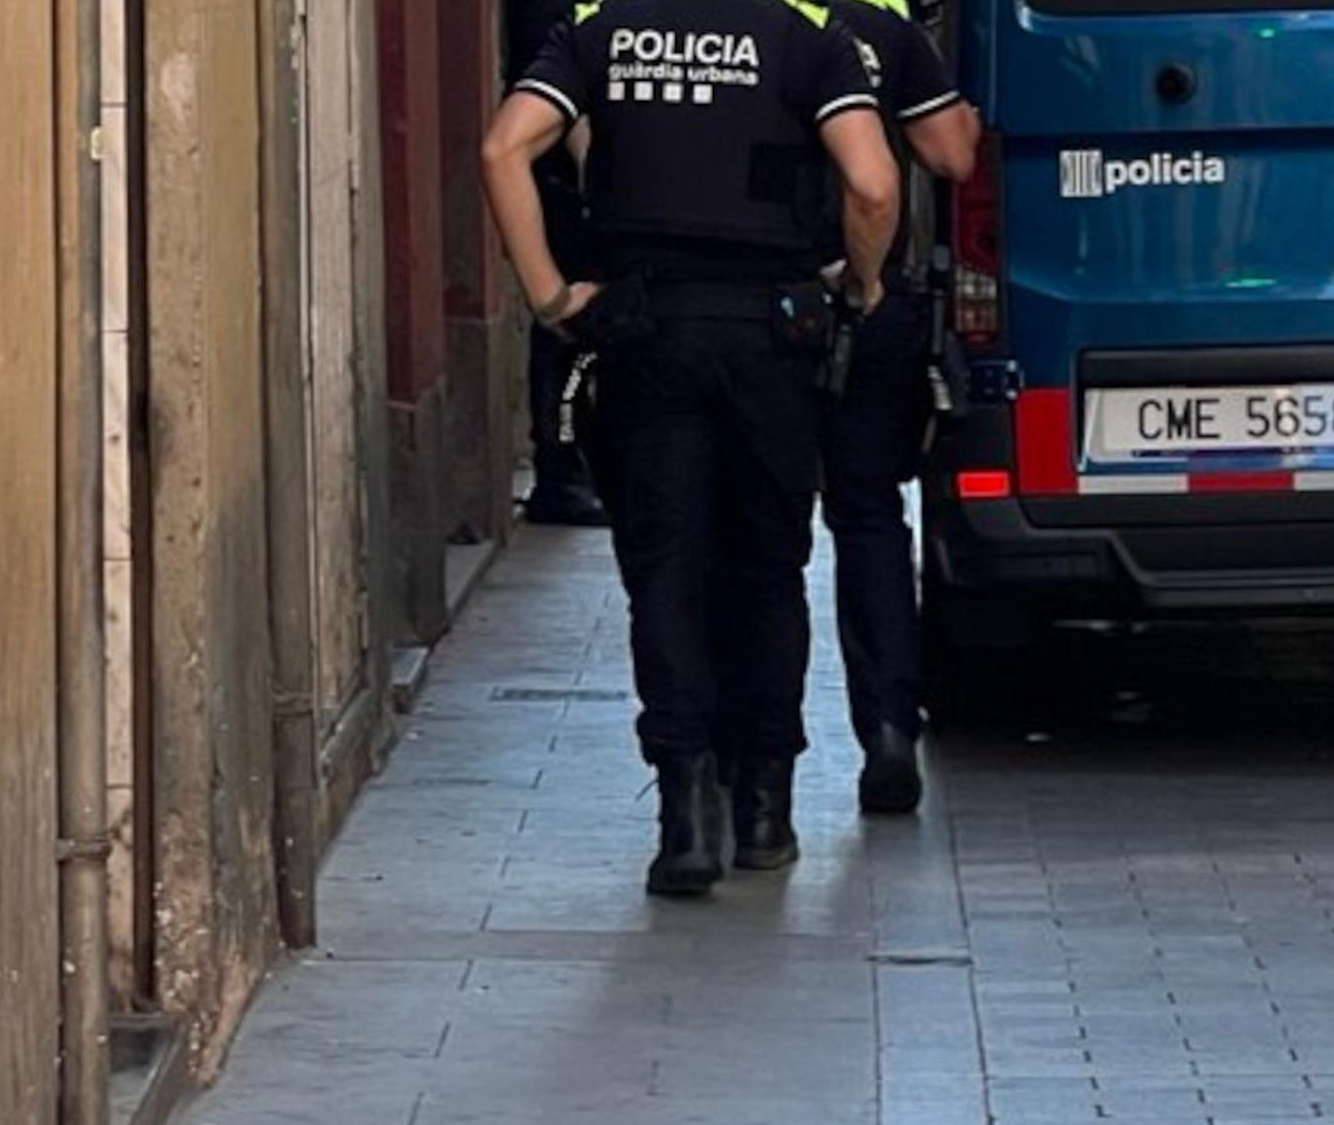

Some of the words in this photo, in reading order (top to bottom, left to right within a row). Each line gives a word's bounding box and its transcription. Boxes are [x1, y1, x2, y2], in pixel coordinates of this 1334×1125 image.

[609, 27, 759, 66] POLICIA
[608, 61, 684, 81] guàrdia
[686, 65, 759, 86] urbana
[1104, 150, 1226, 194] policia
[1137, 398, 1221, 441] CME
